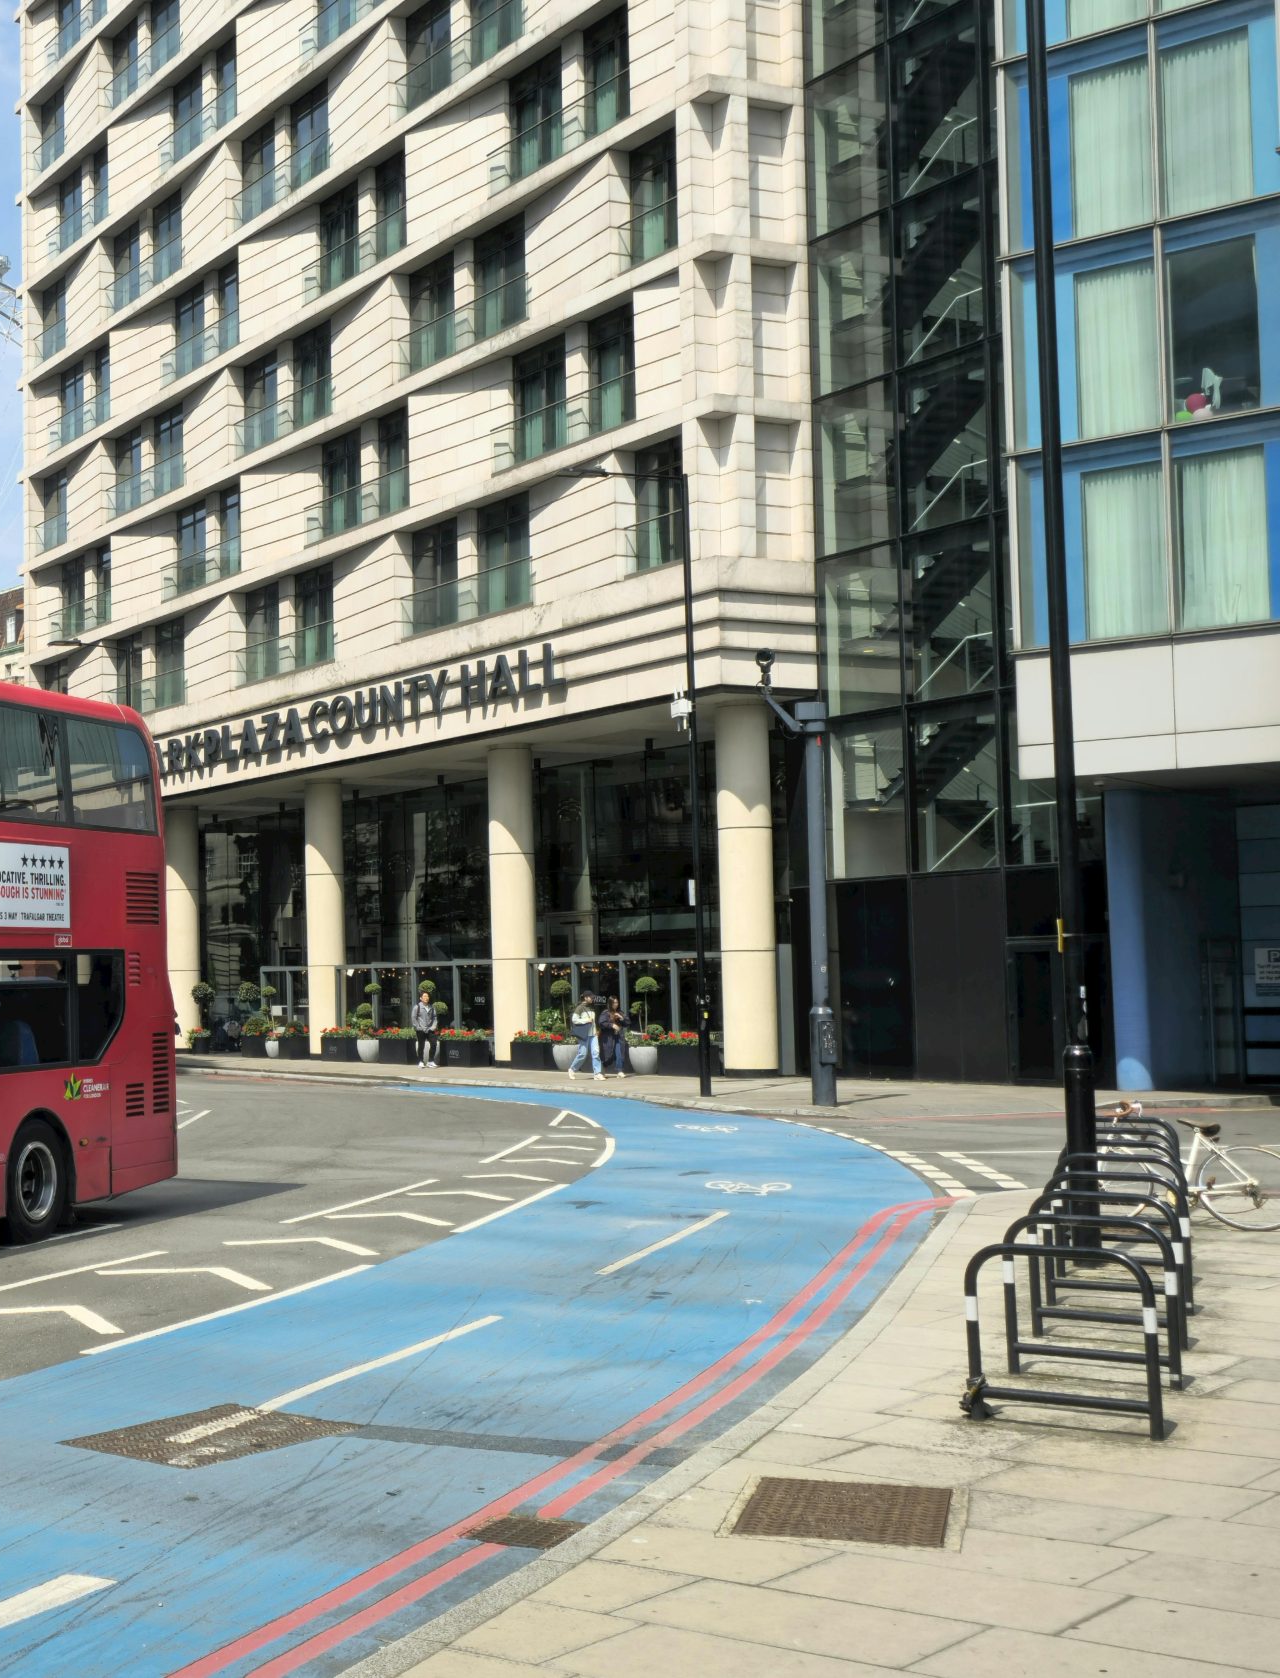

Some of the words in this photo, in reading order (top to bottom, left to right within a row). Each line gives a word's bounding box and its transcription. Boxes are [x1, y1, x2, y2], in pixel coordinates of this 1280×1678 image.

[308, 669, 448, 740] COUNTY
[460, 643, 567, 708] HALL
[30, 872, 66, 886] THRILLING.
[22, 887, 29, 899] IS
[8, 912, 18, 920] MAY
[21, 912, 45, 921] TRAFALGAR
[46, 913, 65, 921] THEATRE
